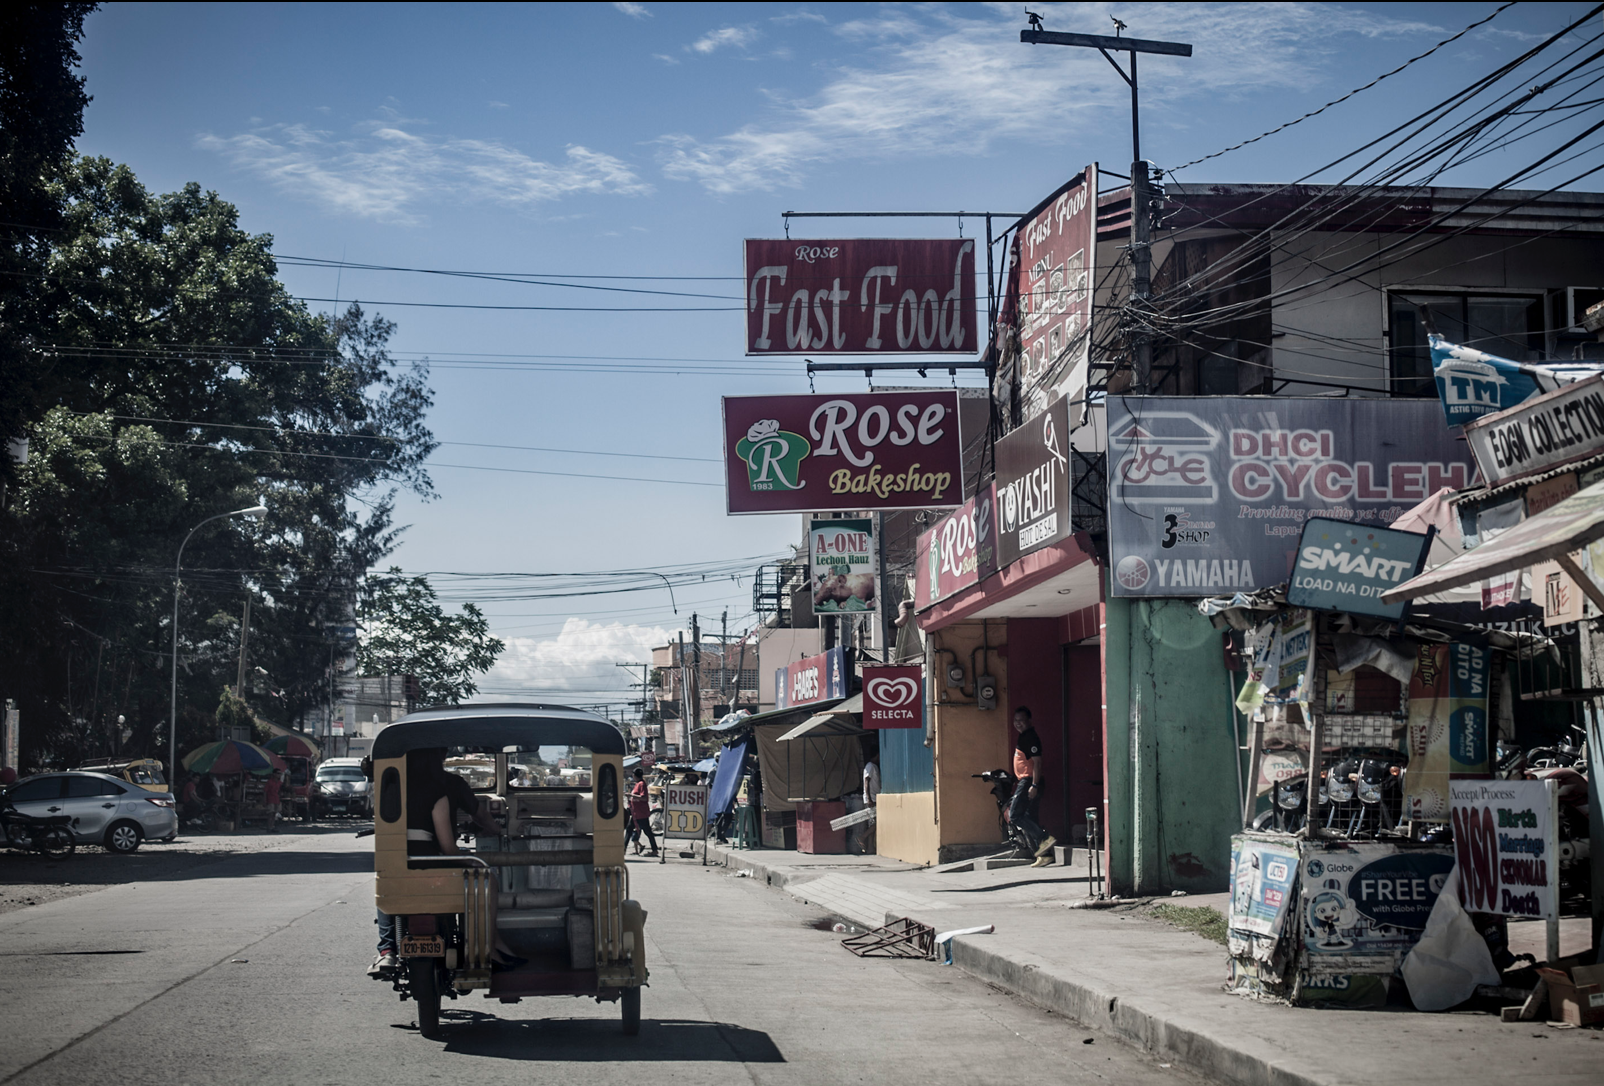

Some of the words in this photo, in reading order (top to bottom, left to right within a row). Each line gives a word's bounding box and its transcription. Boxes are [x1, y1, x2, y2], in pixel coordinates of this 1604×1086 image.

[1026, 211, 1052, 259] Fast
[1056, 181, 1088, 236] Food
[795, 244, 839, 263] Rose
[1028, 251, 1054, 285] MENU
[750, 264, 850, 350] Fast
[861, 241, 974, 350] Food
[1450, 376, 1498, 404] TM
[1450, 406, 1470, 414] ASTIG
[809, 399, 947, 468] Rose
[1232, 432, 1331, 458] DHCI
[752, 483, 774, 491] 1983
[829, 464, 952, 500] Bakeshop
[1238, 505, 1305, 521] Providing
[1308, 504, 1354, 521] quality
[1356, 507, 1377, 521] yet
[816, 532, 868, 555] A-ONE
[940, 498, 990, 577] Rose
[1020, 528, 1032, 548] HOT
[1044, 516, 1056, 537] SAL
[1162, 514, 1178, 548] 3
[1178, 531, 1210, 542] SHOP
[816, 554, 846, 566] Lechon
[848, 554, 870, 566] Hauz
[962, 544, 992, 574] Bakeshop
[1300, 546, 1412, 583] SMART
[1154, 560, 1255, 588] YAMAHA
[1295, 576, 1334, 592] LOAD
[1336, 581, 1356, 596] NA
[1360, 585, 1387, 599] DIT
[1458, 644, 1470, 680] DITO
[1422, 667, 1434, 684] TEXT
[1470, 672, 1482, 694] NA
[871, 710, 914, 720] SELECTA
[1464, 712, 1474, 759] SMART
[669, 790, 704, 806] RUSH
[1450, 786, 1516, 802] Accept/Process:
[668, 810, 704, 832] ID
[1498, 808, 1538, 828] Birth
[1499, 833, 1544, 858] Marriage
[1327, 864, 1354, 872] Globe
[1452, 806, 1498, 911] NSO
[1361, 870, 1418, 878] #ShareYourVibe
[1500, 858, 1548, 887] CENOMAR
[1361, 879, 1426, 901] FREE
[1502, 889, 1540, 915] Death
